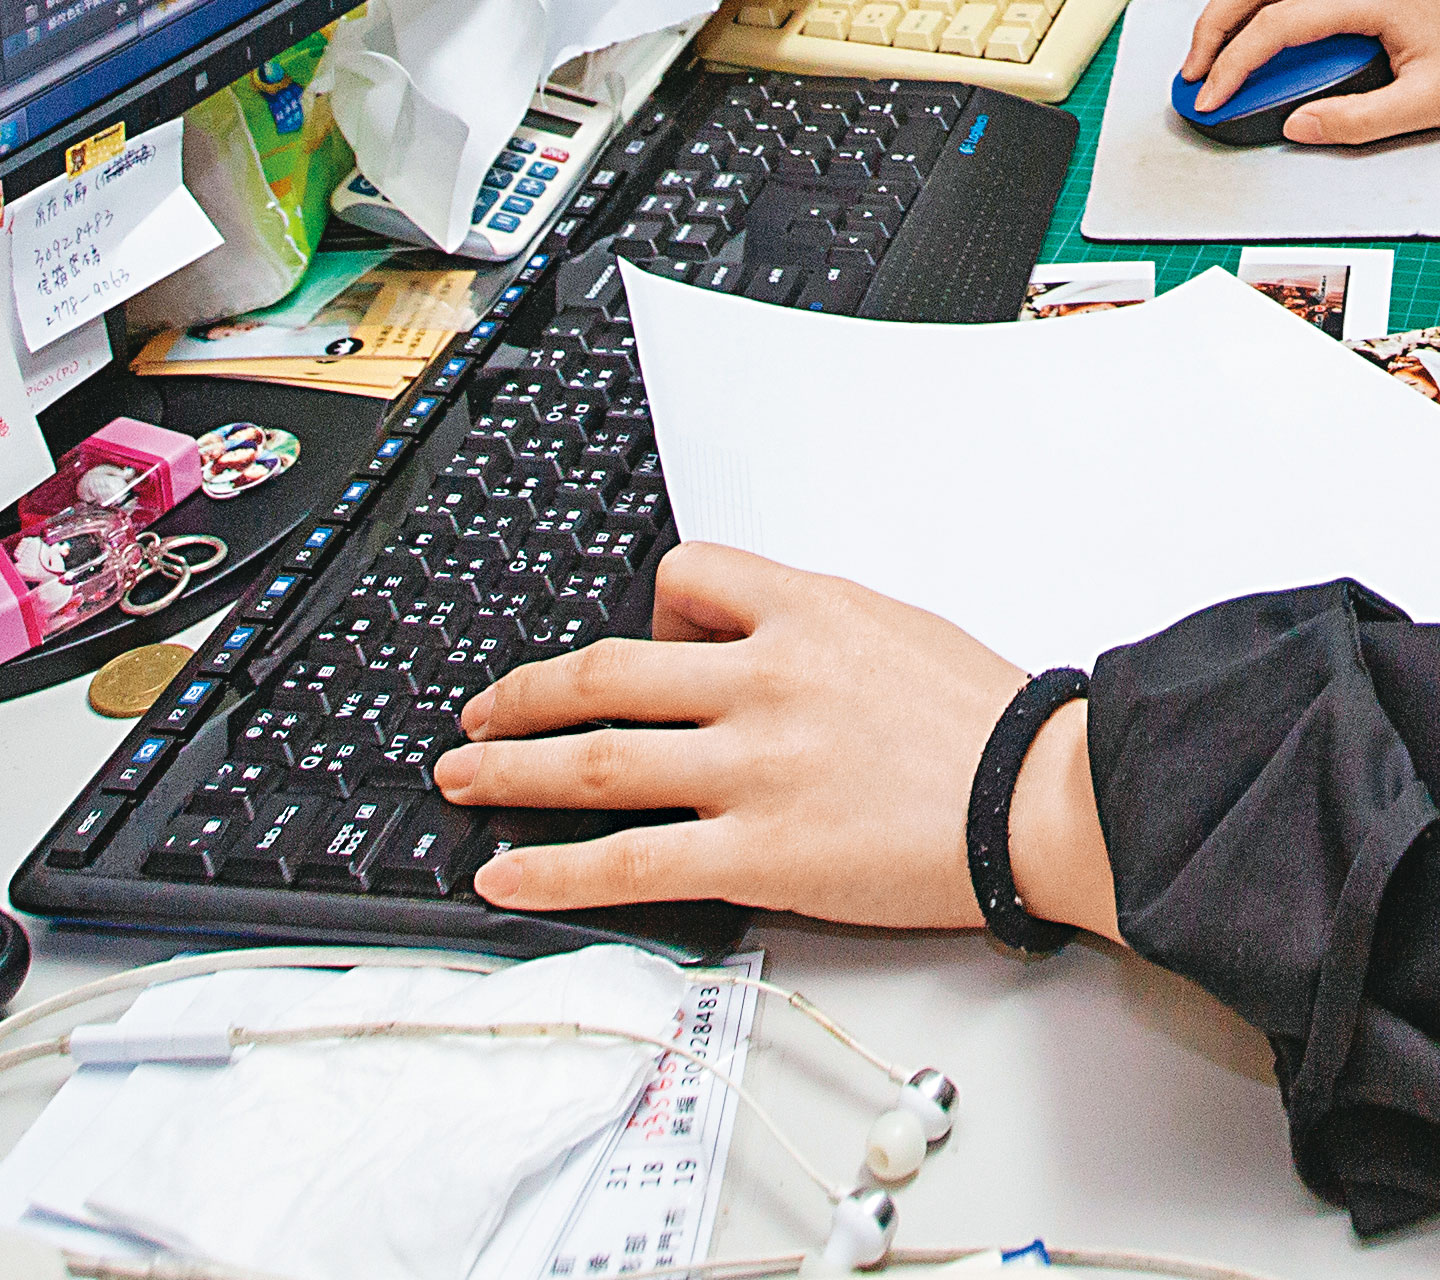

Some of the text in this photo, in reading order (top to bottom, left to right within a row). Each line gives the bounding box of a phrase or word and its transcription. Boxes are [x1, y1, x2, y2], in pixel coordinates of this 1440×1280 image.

[35, 210, 114, 266] 30928483
[38, 244, 103, 296] 信箱密碼
[333, 502, 350, 517] F6
[295, 548, 312, 563] F5
[256, 598, 272, 613] F4
[214, 651, 231, 666] F3
[169, 707, 187, 722] F2
[120, 767, 138, 780] F1
[77, 808, 103, 835] esc
[257, 824, 282, 850] tab
[327, 823, 354, 853] caps
[413, 832, 437, 859] shift
[606, 1163, 631, 1190] 31
[640, 1160, 664, 1187] 18
[673, 1158, 697, 1185] 19
